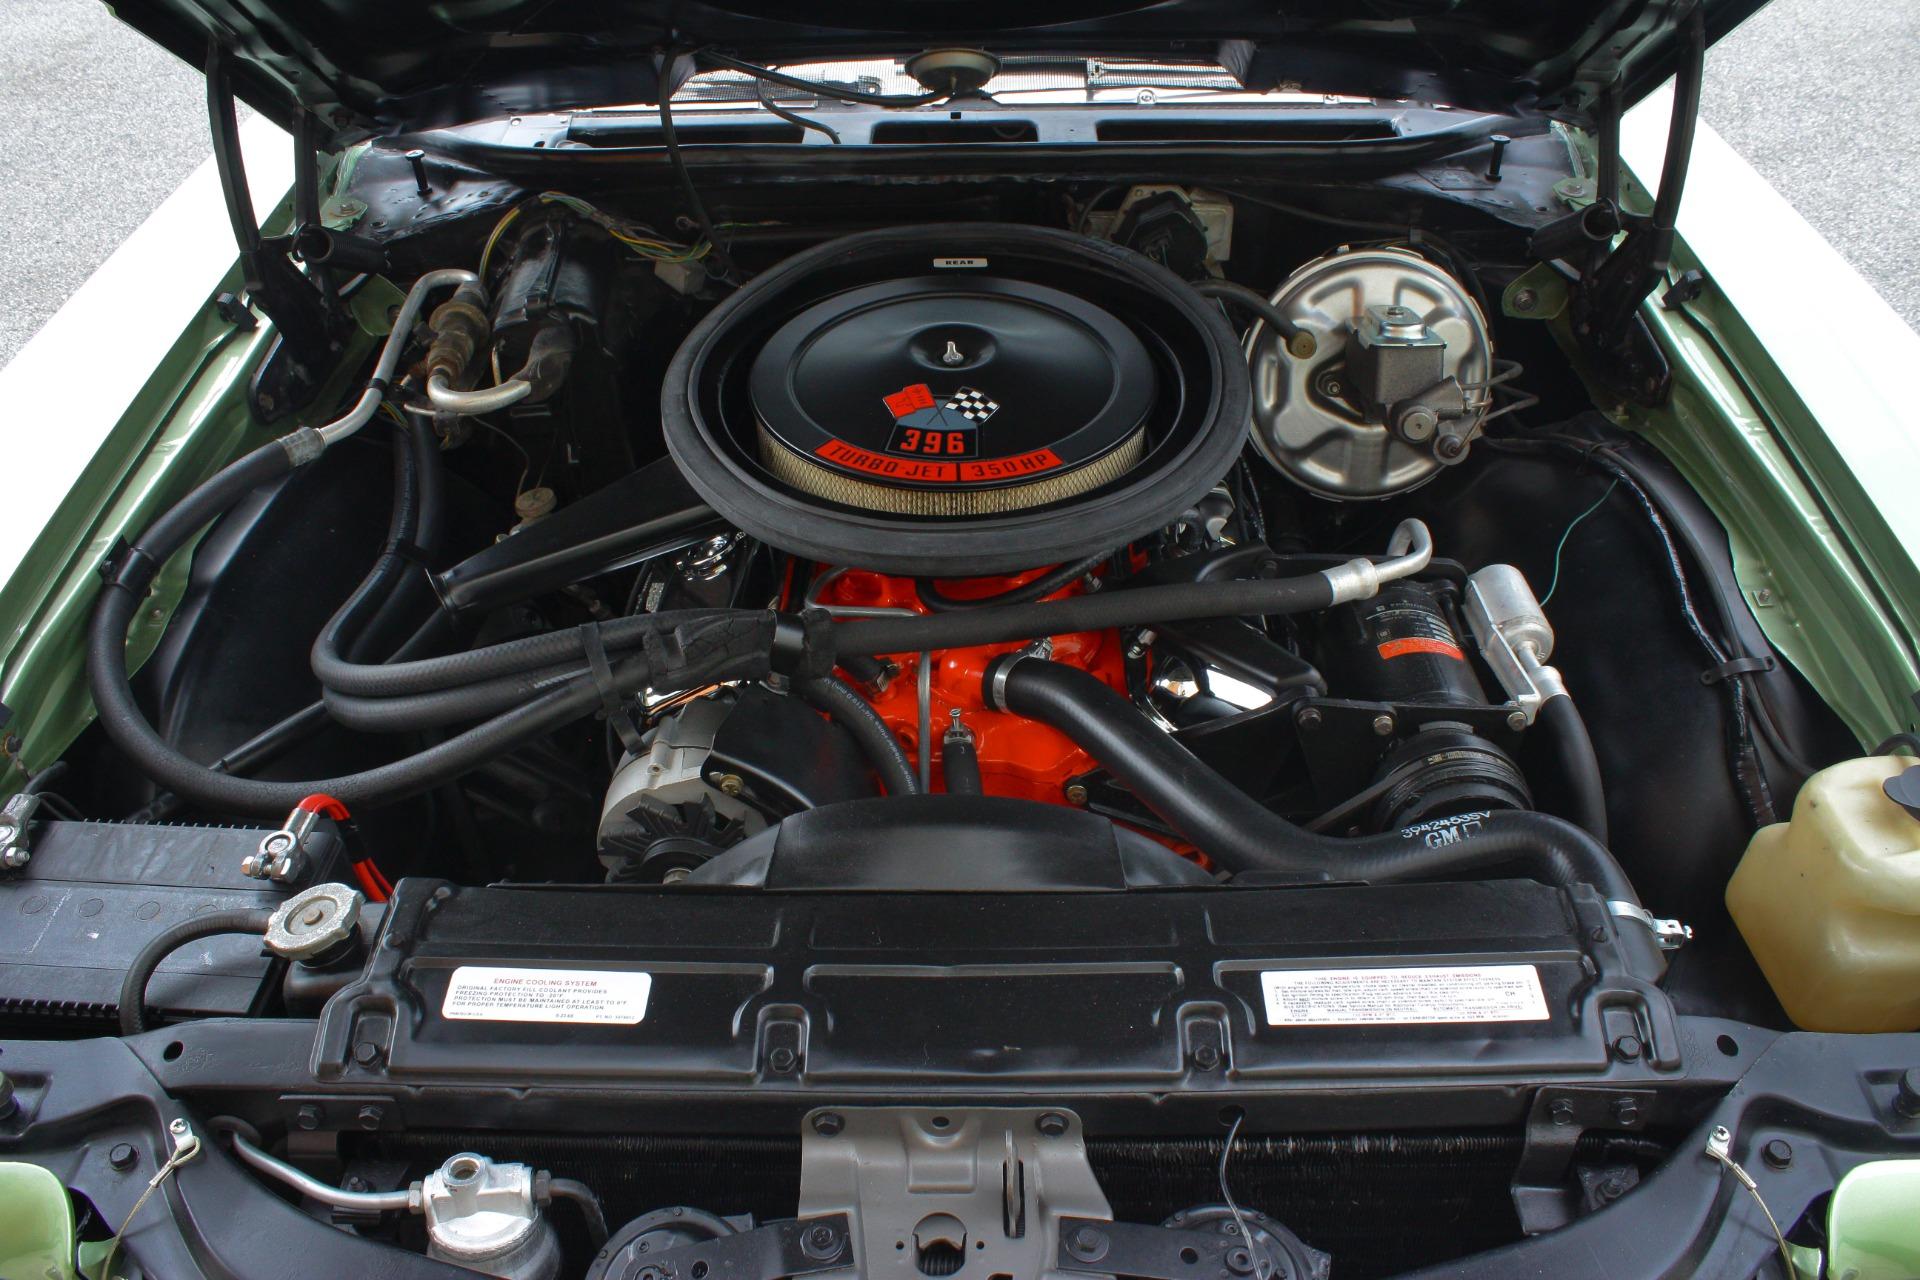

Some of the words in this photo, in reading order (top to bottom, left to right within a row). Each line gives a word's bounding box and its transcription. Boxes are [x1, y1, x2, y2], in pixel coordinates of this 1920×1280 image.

[899, 428, 965, 455] 396
[829, 444, 897, 474] TURBO
[1425, 825, 1461, 850] GM
